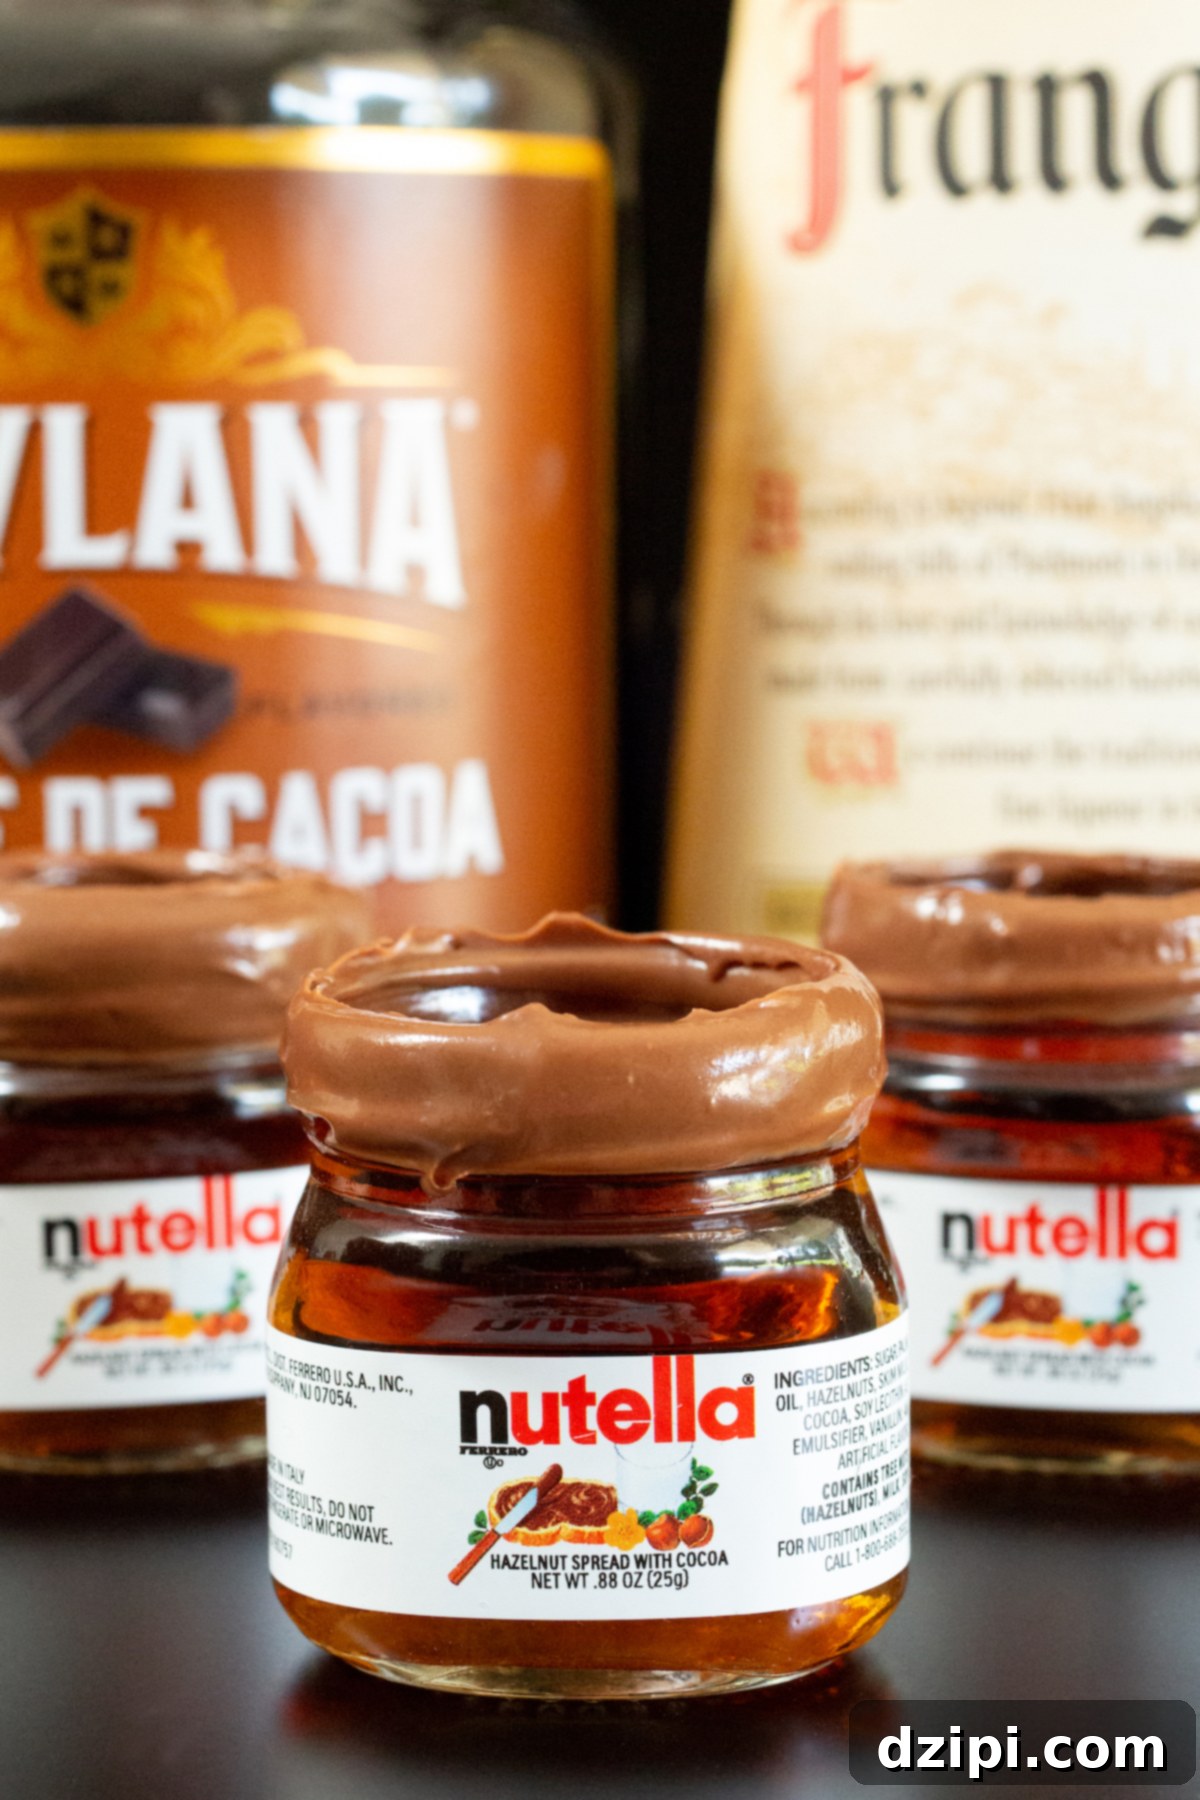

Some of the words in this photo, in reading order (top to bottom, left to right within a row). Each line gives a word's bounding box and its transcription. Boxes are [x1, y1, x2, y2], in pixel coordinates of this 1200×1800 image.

[200, 757, 505, 888] CACOA
[44, 1173, 282, 1259] nutella
[941, 1184, 1178, 1260] nutella
[288, 1358, 332, 1385] FERRERO
[333, 1369, 376, 1393] U.S.A.,
[378, 1374, 414, 1396] INC.,
[774, 1354, 873, 1390] INGREDIENTS:
[300, 1381, 312, 1401] NJ
[314, 1385, 358, 1409] 07054.
[459, 1354, 756, 1445] nutella
[803, 1407, 852, 1432] COCOA,
[854, 1399, 874, 1421] SOY
[459, 1445, 528, 1456] FERRERO
[822, 1468, 879, 1501] CONTAINS
[328, 1499, 346, 1519] DO
[349, 1502, 375, 1524] NOT
[315, 1516, 394, 1547] MICROWAVE.
[777, 1538, 805, 1558] FOR
[807, 1522, 868, 1554] NUTRITION
[491, 1553, 567, 1570] HAZELNUT
[571, 1553, 631, 1571] SPREAD
[634, 1552, 673, 1570] WITH
[676, 1550, 729, 1568] COCOA
[824, 1550, 853, 1573] CALL
[531, 1572, 561, 1589] NET
[565, 1572, 589, 1589] WT
[593, 1571, 618, 1589] .88
[622, 1570, 643, 1588] OZ
[647, 1568, 689, 1590] (25g)
